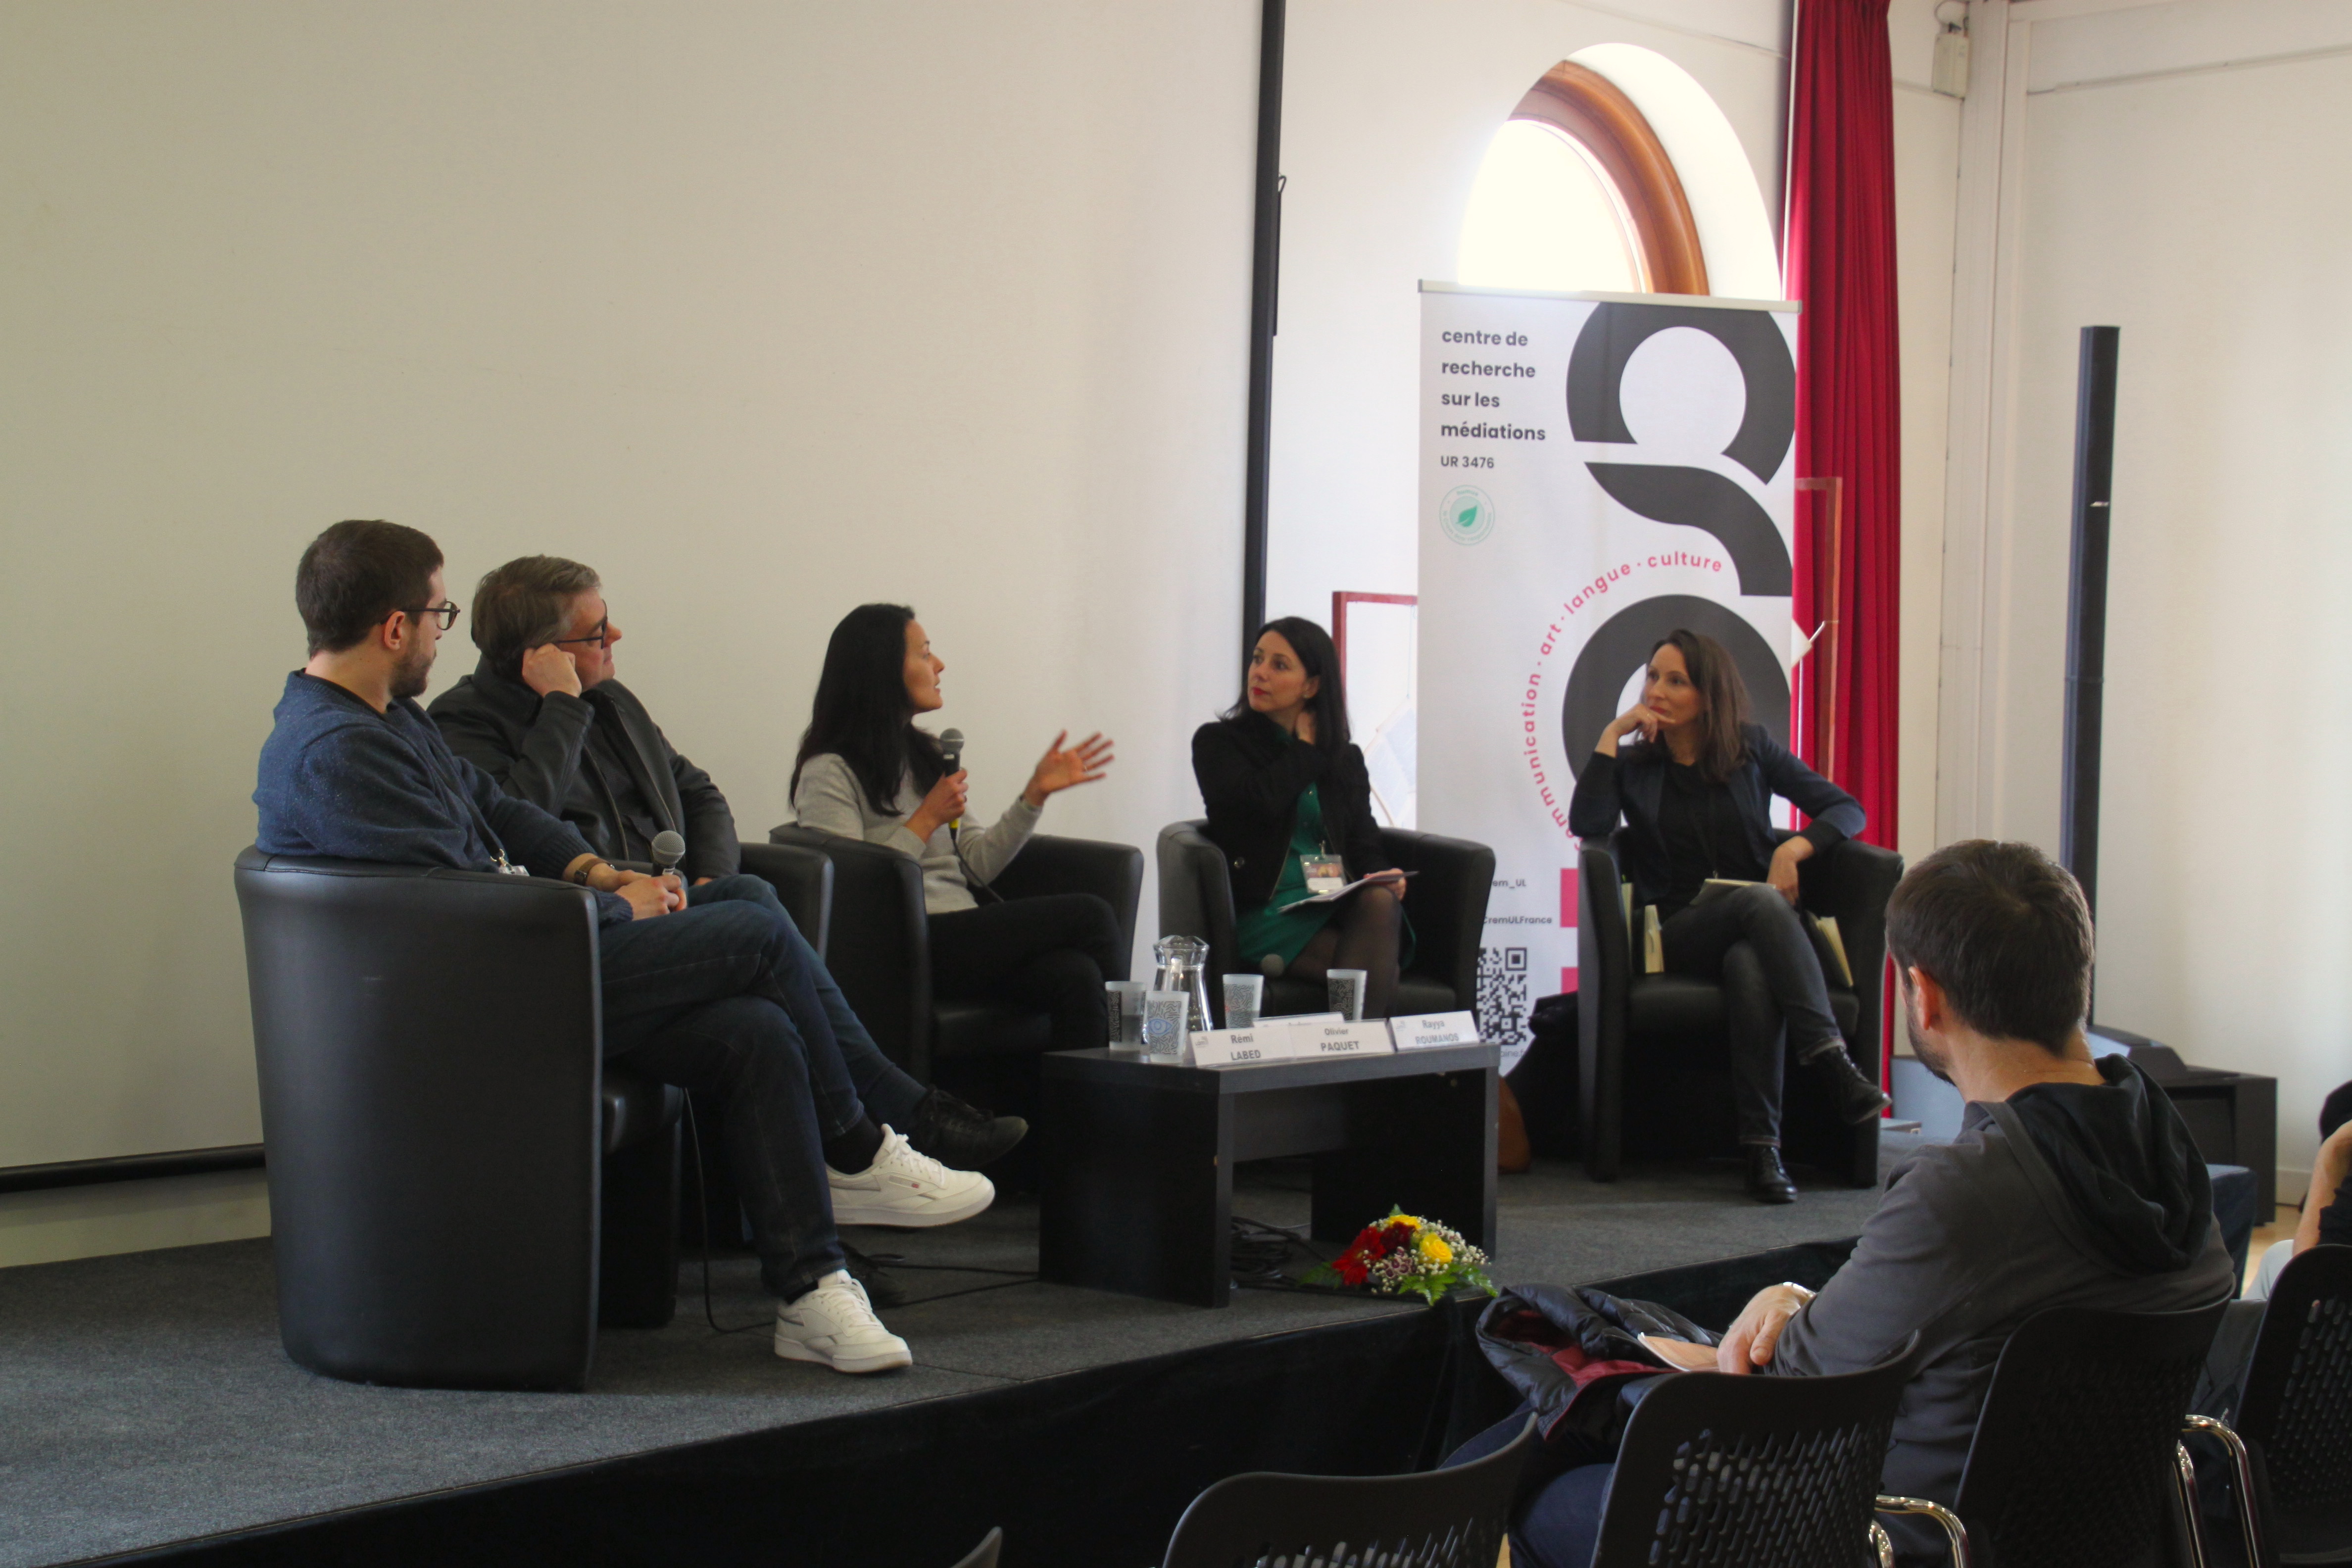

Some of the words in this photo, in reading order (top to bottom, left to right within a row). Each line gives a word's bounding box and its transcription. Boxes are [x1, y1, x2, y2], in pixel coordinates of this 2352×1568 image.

[1441, 330, 1501, 345] centre
[1505, 331, 1528, 346] de
[1441, 360, 1536, 378] recherche
[1441, 393, 1471, 406] sur
[1474, 391, 1500, 408] les
[1440, 420, 1546, 441] médiations
[1440, 455, 1459, 467] UR
[1462, 455, 1495, 469] 3476
[1540, 624, 1562, 656] art
[1564, 564, 1631, 614] langue
[1647, 550, 1722, 573] culture
[1492, 879, 1526, 888] em_UL
[1421, 1019, 1445, 1030] Rayya
[1230, 1033, 1254, 1044] Rémi
[1324, 1028, 1349, 1036] Olivier
[1320, 1040, 1360, 1052] PAQUET
[1230, 1049, 1261, 1061] LABED
